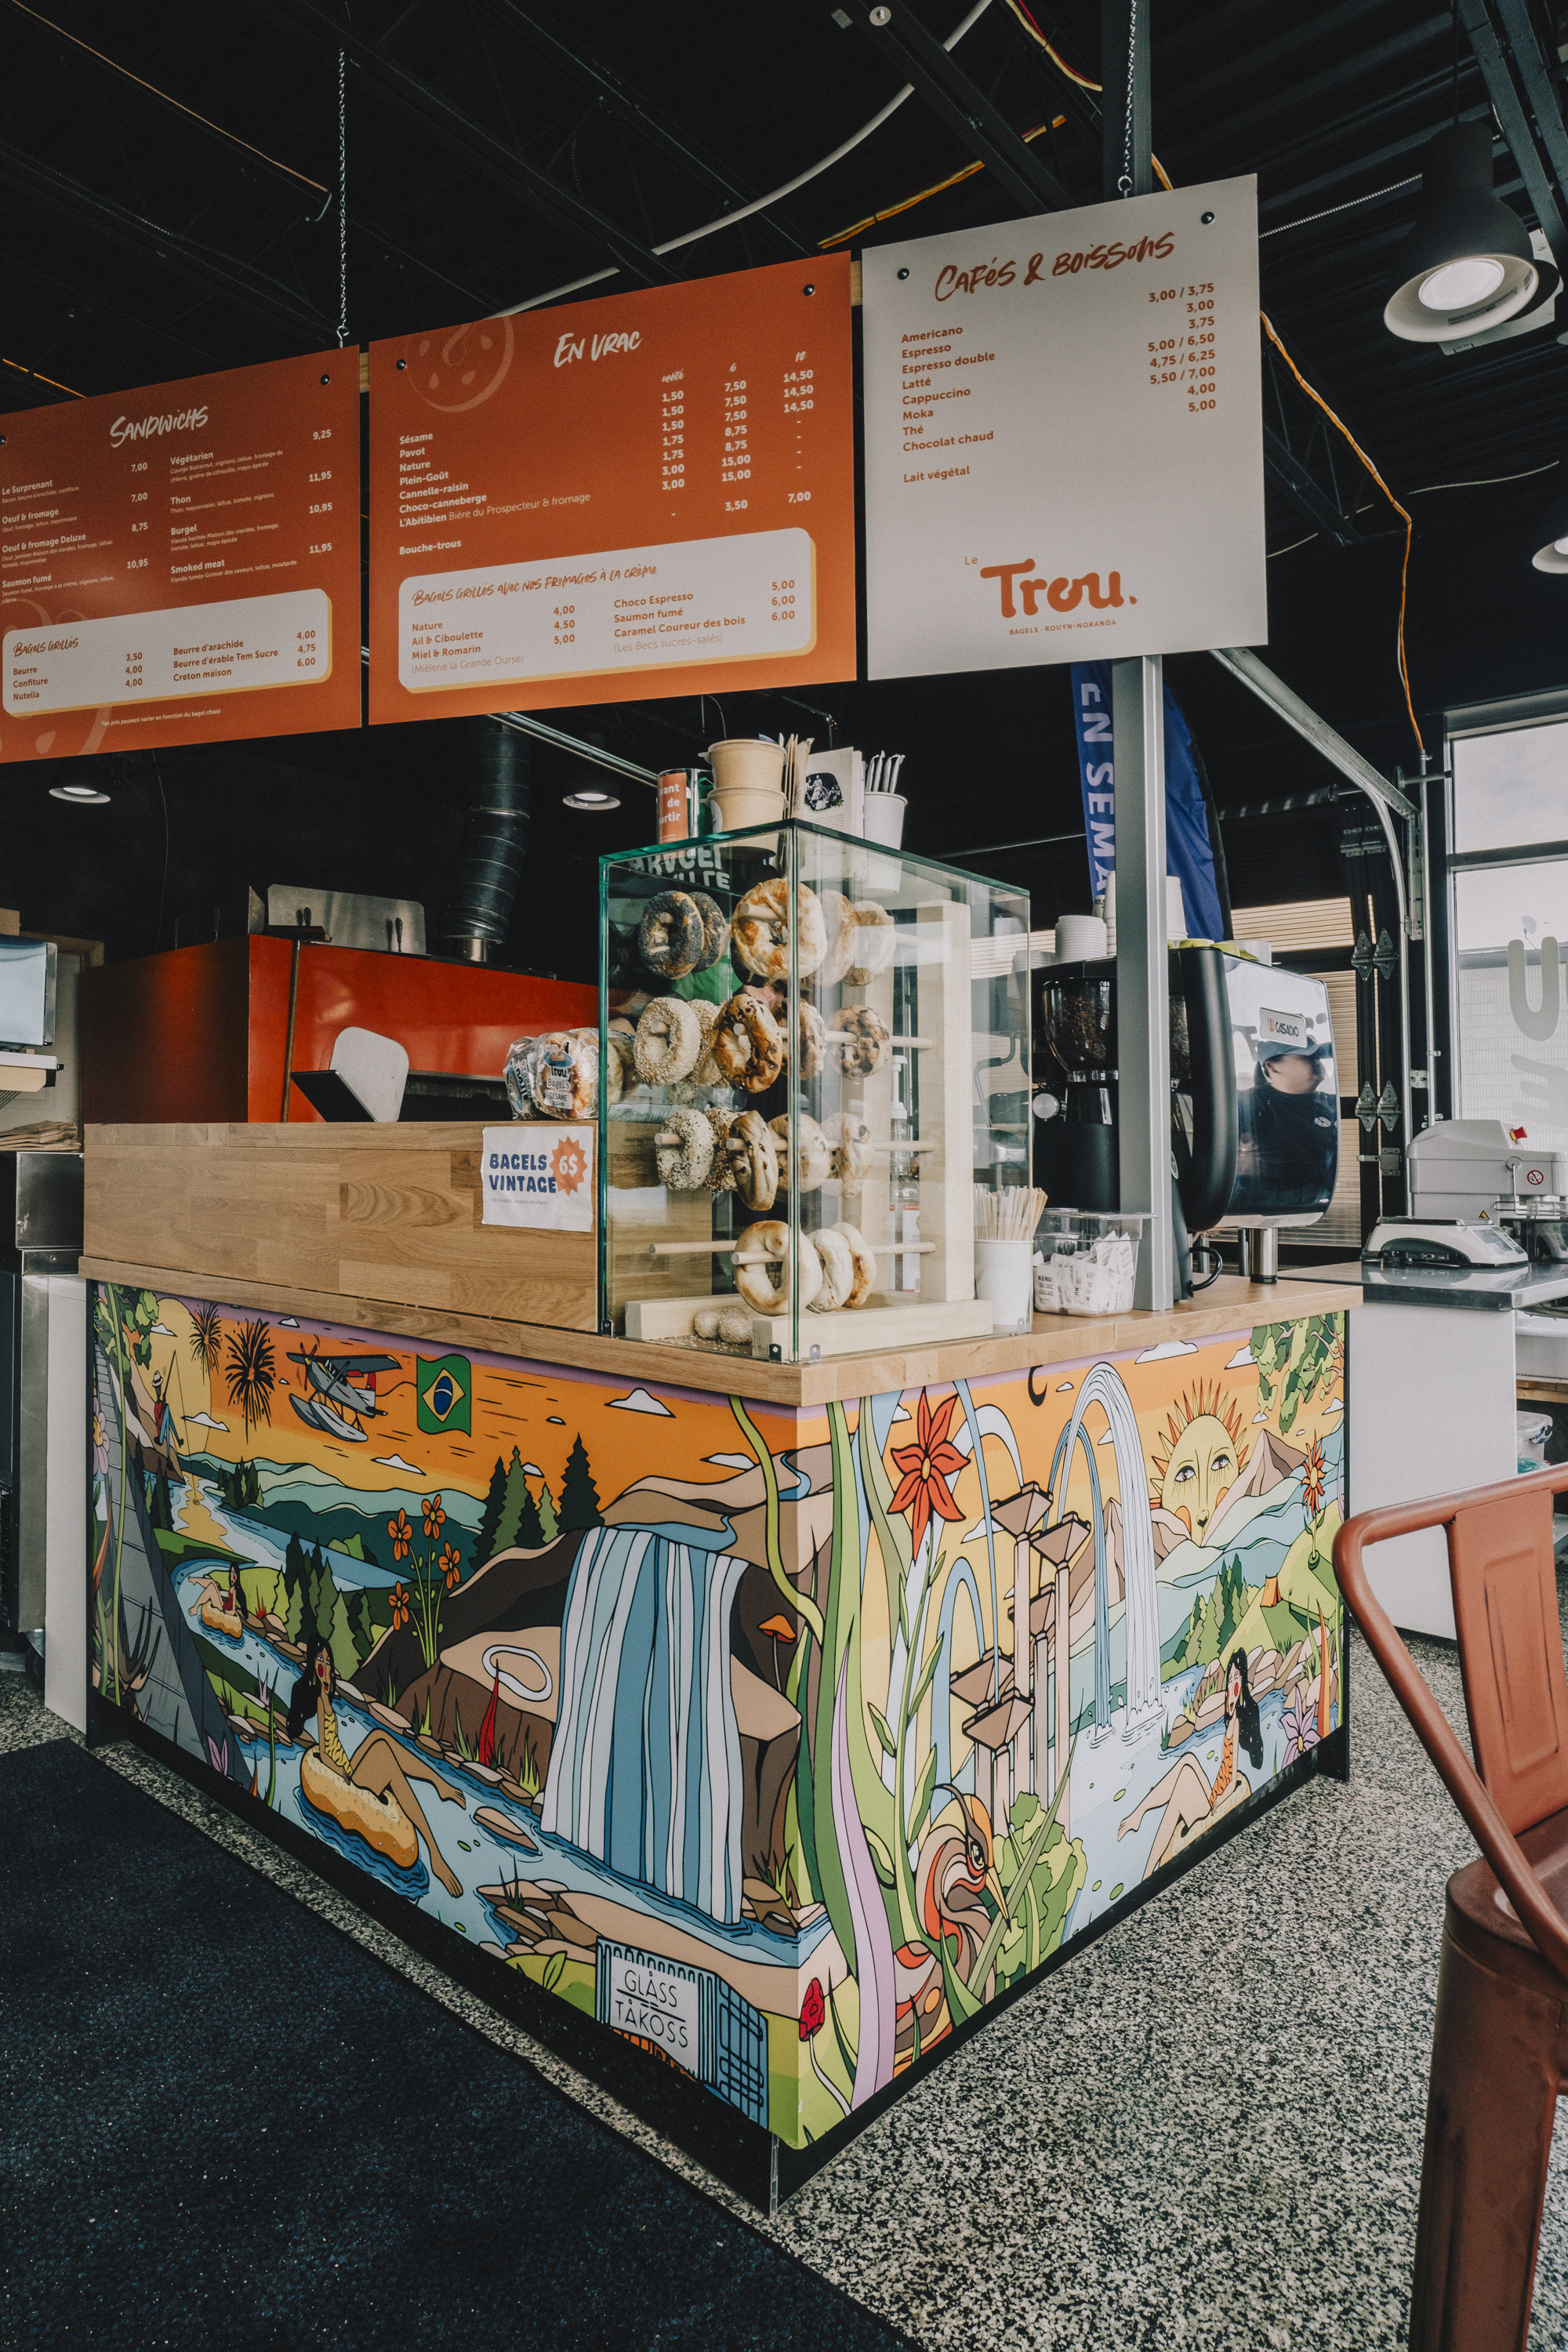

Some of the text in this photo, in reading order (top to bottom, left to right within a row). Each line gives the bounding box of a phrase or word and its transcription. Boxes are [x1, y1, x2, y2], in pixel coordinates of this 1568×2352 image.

[1023, 252, 1045, 285] &
[1149, 282, 1214, 303] 3,00 3,75
[1187, 299, 1214, 312] 3,00
[1189, 316, 1214, 328] 3,75
[902, 327, 963, 343] Americano
[1148, 332, 1215, 352] 5,00 6,50
[796, 351, 806, 361] 12
[902, 345, 951, 358] Espresso
[902, 352, 996, 374] Espresso double
[1149, 349, 1215, 368] 4,75 6,25
[730, 363, 736, 372] 6
[784, 369, 813, 383] 14,50
[1150, 365, 1215, 384] 5,50 7,00
[725, 380, 746, 392] 7,50
[902, 377, 931, 390] Latté
[662, 390, 684, 401] 1,50
[902, 389, 971, 405] Cappuccino
[1189, 399, 1216, 412] 5,00
[903, 409, 933, 420] Moka
[313, 430, 331, 440] 9,25
[725, 425, 746, 436] 8,75
[902, 426, 924, 435] Thé
[400, 434, 433, 445] Sésame
[663, 434, 684, 446] 1,75
[903, 430, 994, 452] Chocolat chaud
[170, 452, 213, 465] Végétarien
[400, 448, 425, 458] Pavot
[400, 462, 430, 472] Nature
[722, 455, 750, 466] 15,00
[132, 463, 147, 472] 7,00
[662, 464, 684, 475] 3,00
[310, 471, 332, 481] 11,95
[400, 471, 448, 485] Plein-Goût
[903, 466, 971, 483] Lait végétal
[12, 480, 53, 493] Surprenant
[399, 482, 469, 499] Cannelle-raisin
[788, 492, 811, 503] 7,00
[399, 495, 487, 514] Choco-canneberge
[400, 514, 447, 528] L'Abitibien
[448, 511, 470, 520] Bière
[487, 501, 539, 514] Prospecteur
[543, 498, 549, 506] &
[552, 494, 590, 505] fromage
[132, 522, 148, 532] 8,75
[171, 524, 197, 535] Burgel
[2, 543, 20, 553] Oeuf
[28, 539, 59, 548] fromage
[61, 534, 86, 543] Deluxe
[400, 540, 461, 555] Bouche-trous
[127, 558, 148, 568] 10,95
[171, 560, 224, 574] Smoked meat
[965, 557, 978, 565] Le
[2, 574, 52, 588] Saumon fumé
[772, 580, 795, 590] 5,00
[980, 558, 1138, 619] Trou.
[614, 593, 693, 608] Choco Espresso
[771, 595, 795, 606] 6,00
[554, 605, 575, 615] 4,00
[615, 608, 684, 622] Saumon fumé
[412, 622, 443, 631] Nature
[554, 619, 575, 630] 4,50
[614, 616, 745, 637] Caramel Coureur des bois
[1045, 619, 1116, 631] ROUYN-NORANDA
[297, 630, 315, 640] 4,00
[412, 631, 483, 645] Ail & Ciboulette
[554, 634, 575, 644] 5,00
[173, 640, 243, 655] Beurre d'arachide
[298, 644, 315, 653] 4,75
[614, 633, 723, 652] (Les Becs sucrés-salés)
[126, 652, 143, 661] 3,50
[412, 645, 481, 659] Miel & Romarin
[173, 659, 200, 669] Beurre
[201, 655, 234, 665] d'érable
[255, 650, 278, 659] Sucre
[125, 665, 143, 674] 4,00
[13, 679, 48, 688] Confiture
[173, 673, 201, 681] Creton
[659, 783, 680, 795] vant
[667, 798, 680, 808] de
[1276, 1022, 1298, 1037] CASADIO
[548, 1079, 570, 1089] Bagels
[490, 1153, 547, 1171] BAGELS
[559, 1154, 578, 1177] 6$
[489, 1175, 556, 1193] VINTAGE
[625, 1970, 677, 2007] GLÅSS
[615, 1998, 688, 2048] TÅKOSS
